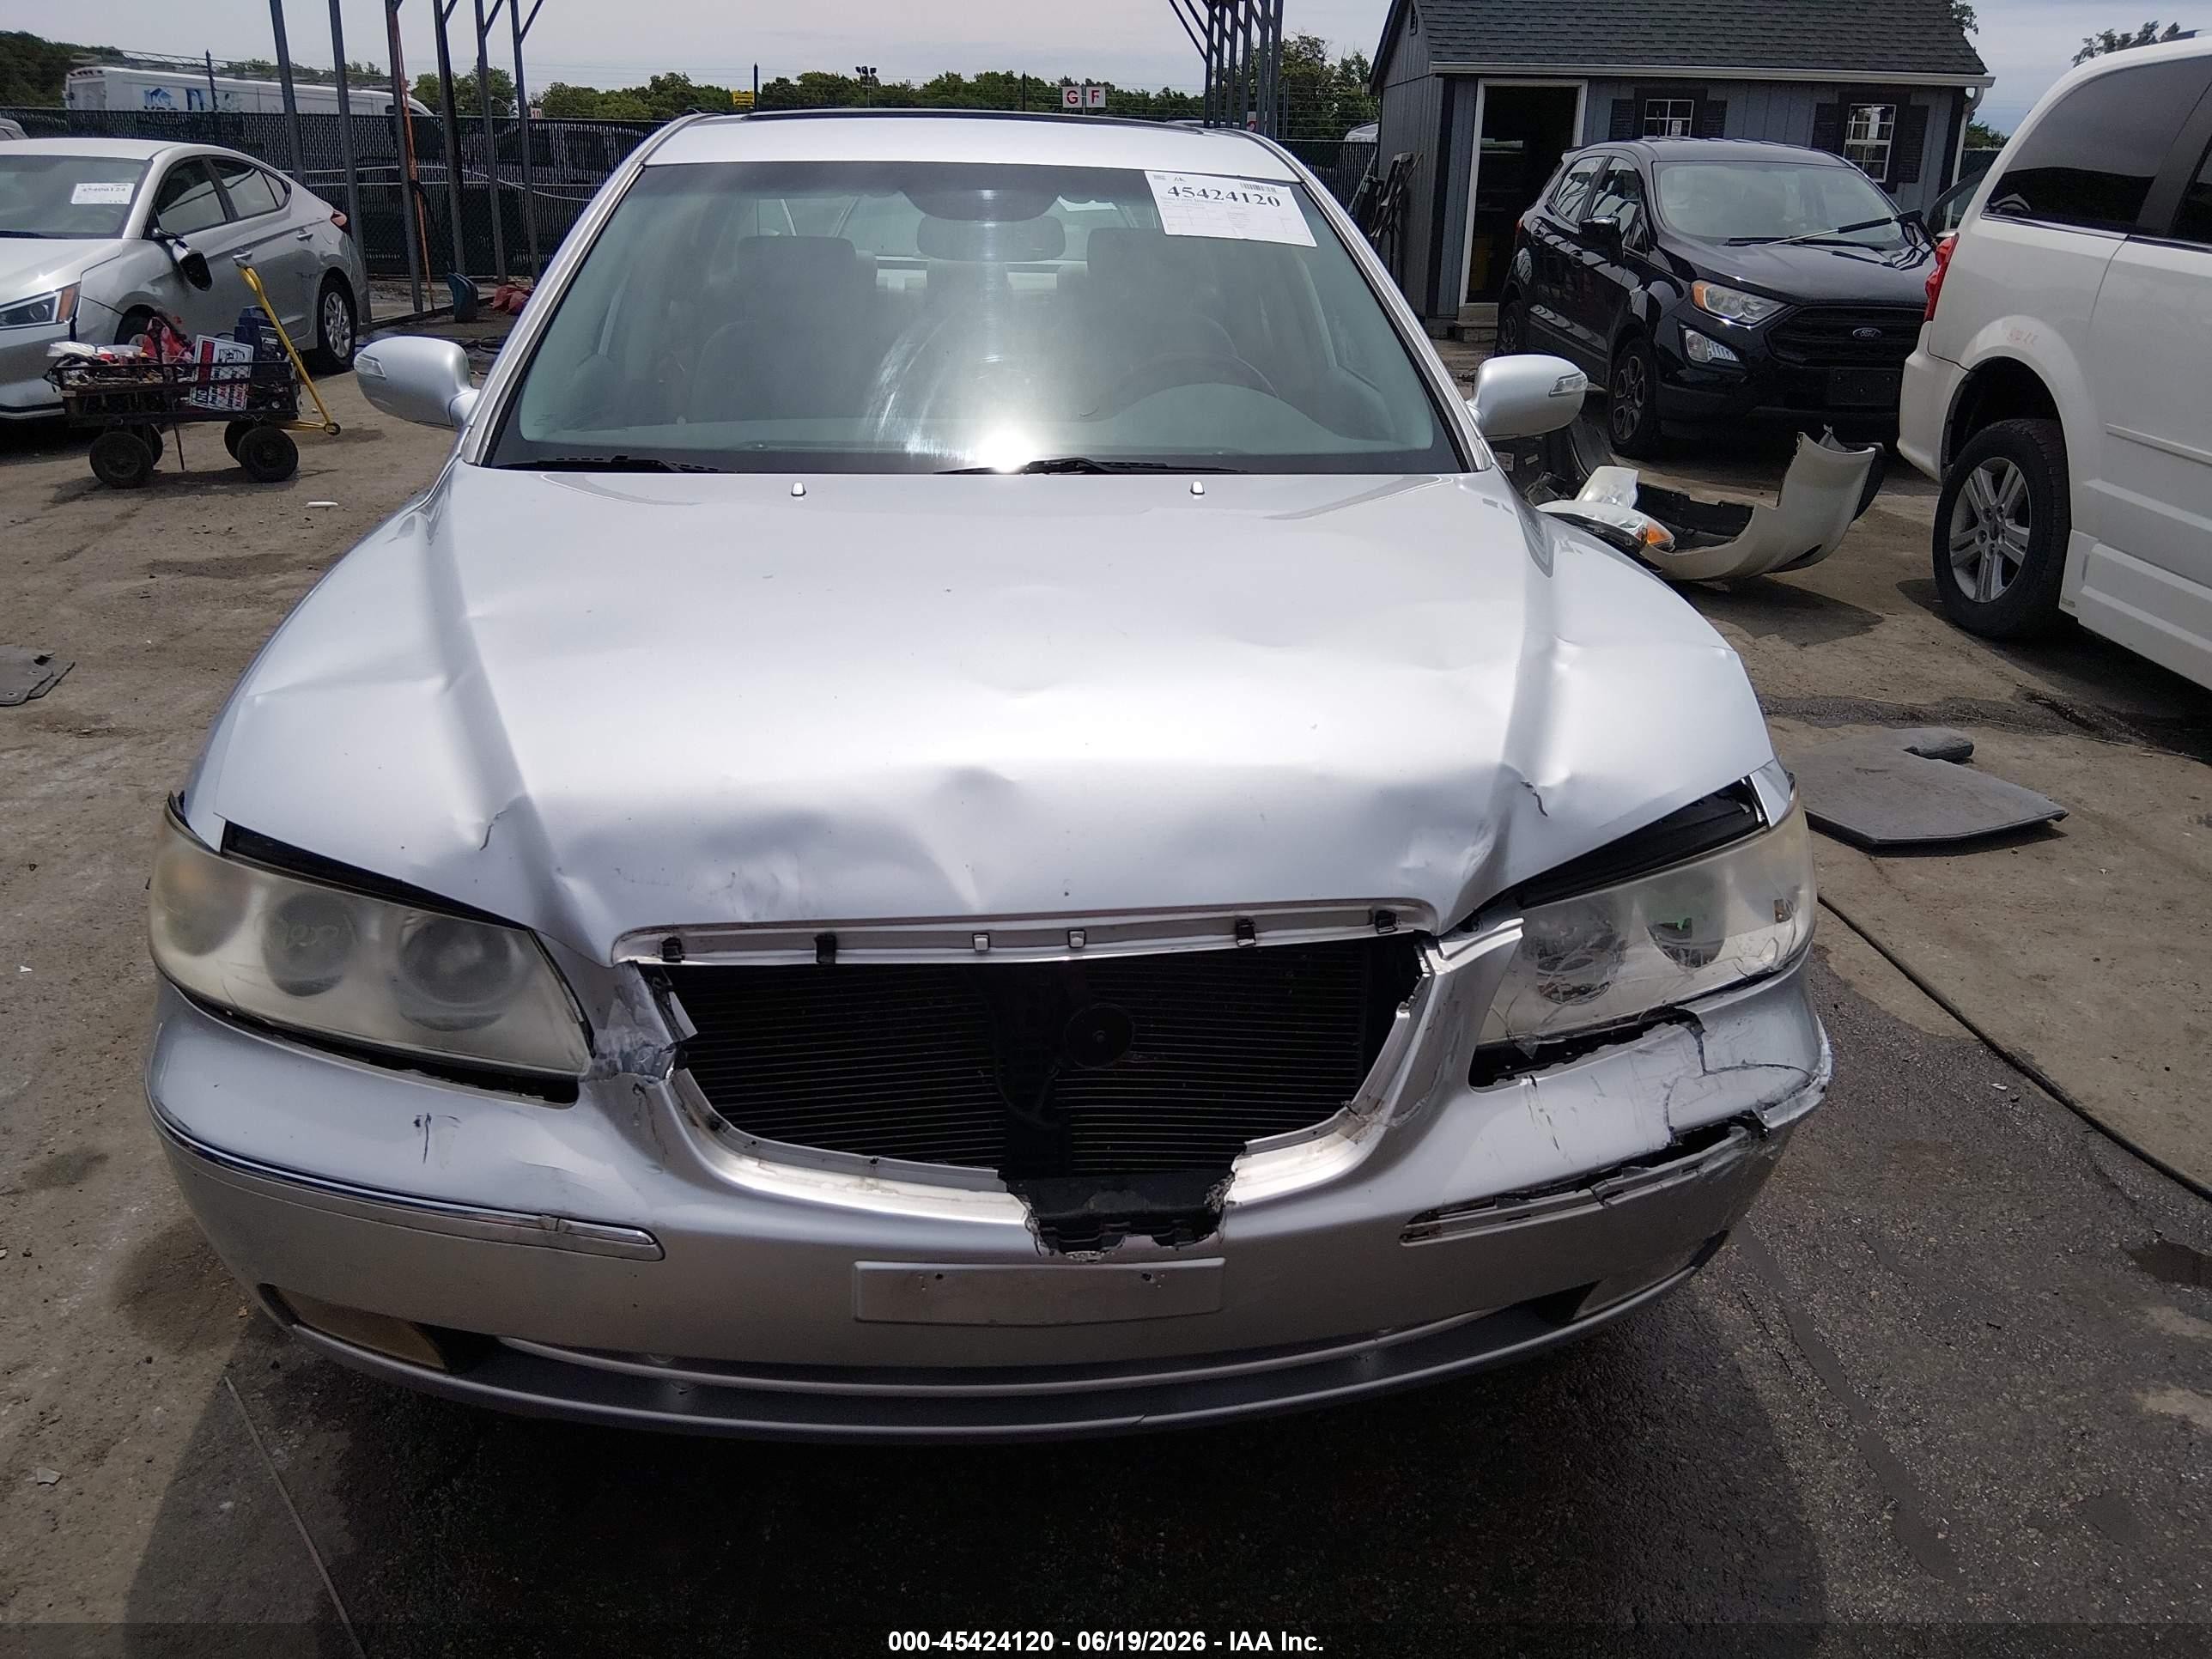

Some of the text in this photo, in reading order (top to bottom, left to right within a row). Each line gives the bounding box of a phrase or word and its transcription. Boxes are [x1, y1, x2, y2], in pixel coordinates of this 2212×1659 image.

[1066, 90, 1079, 104] G
[1091, 90, 1100, 104] F
[1167, 185, 1281, 208] 45424120
